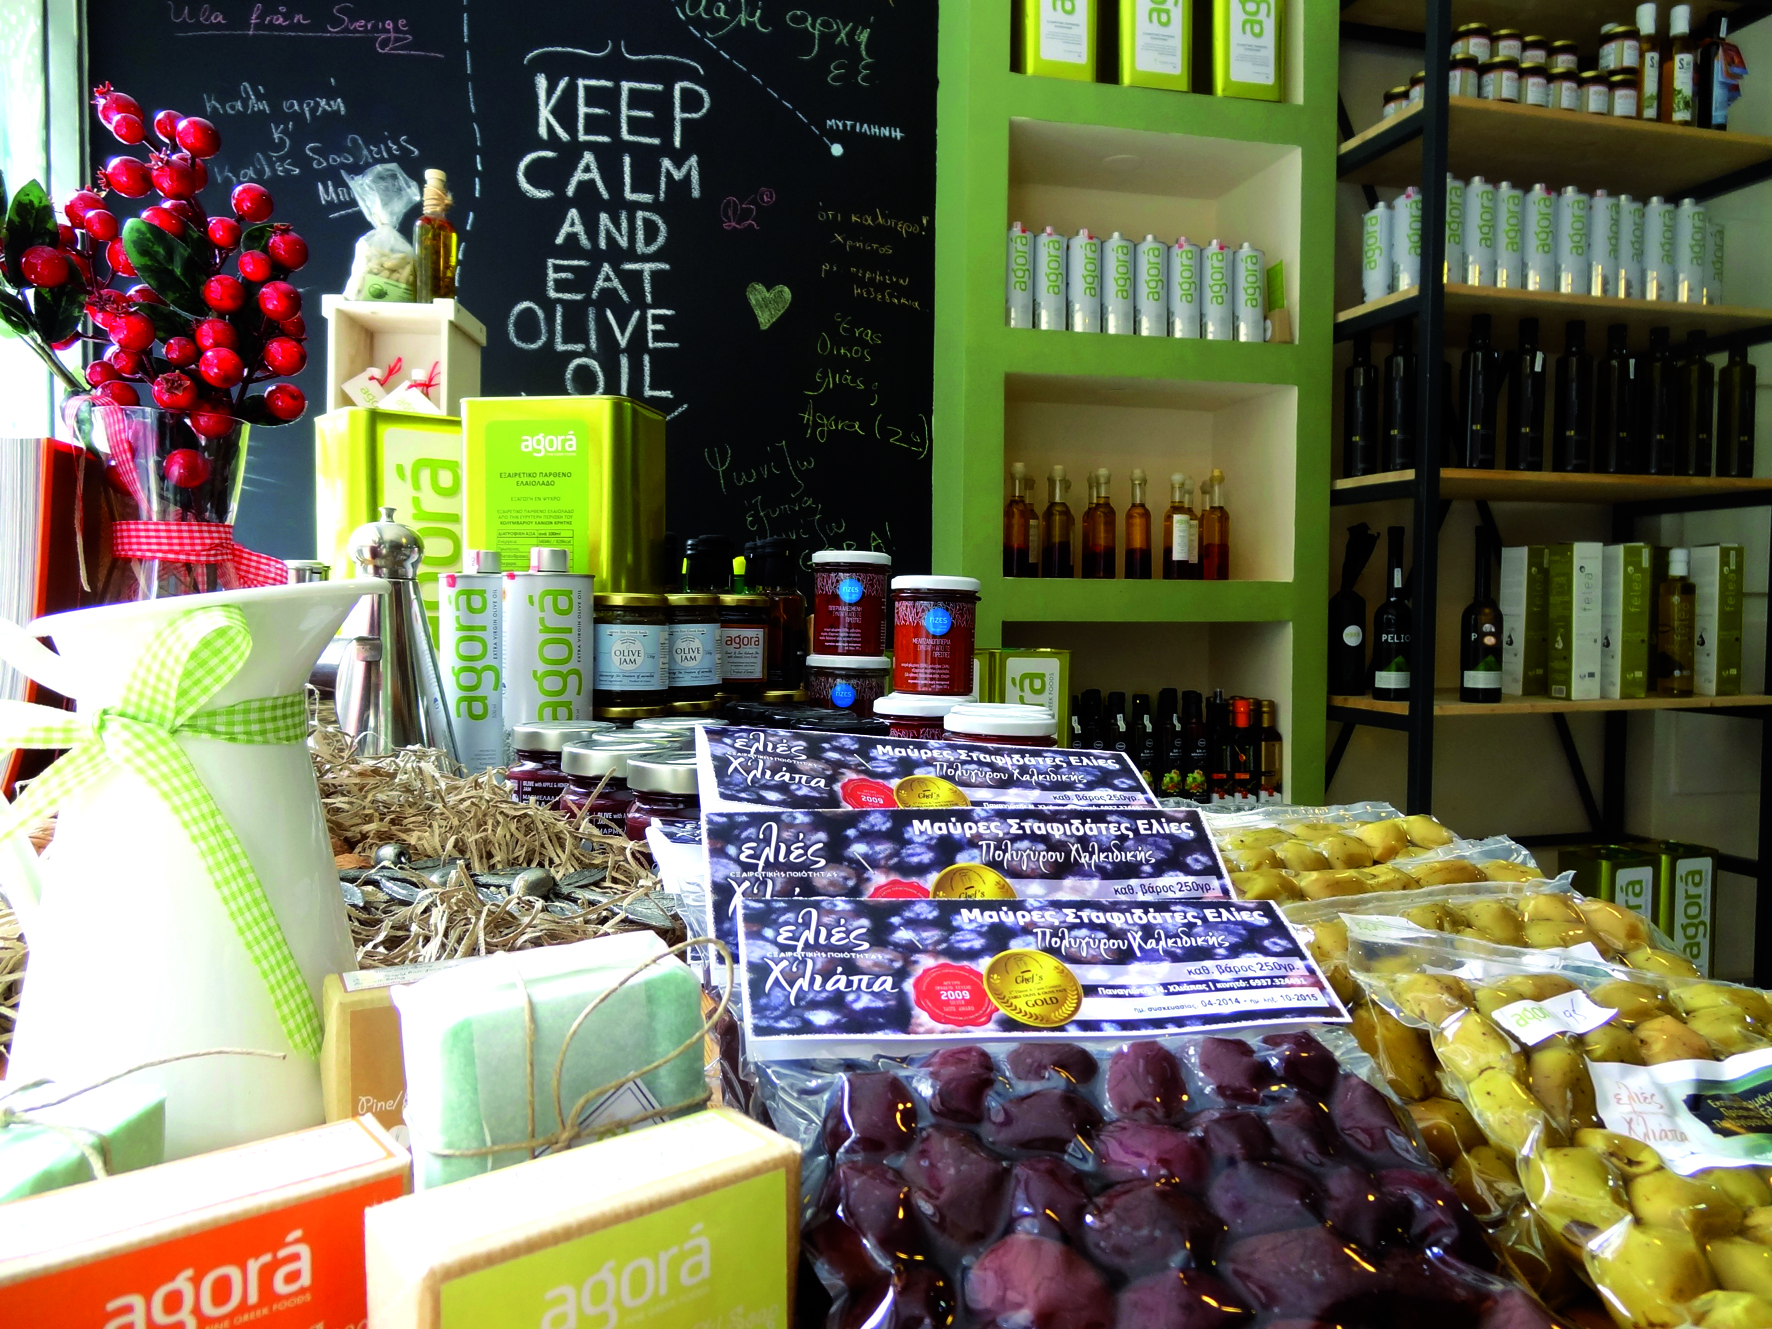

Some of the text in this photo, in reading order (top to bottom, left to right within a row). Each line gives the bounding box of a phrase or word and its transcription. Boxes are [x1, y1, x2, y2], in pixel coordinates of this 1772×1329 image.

[535, 73, 711, 148] KEEP
[826, 119, 905, 140] ΜΥΤΙΛΗΝΗ
[516, 151, 700, 202] CALM
[555, 208, 668, 255] AND
[546, 258, 670, 304] EAT
[508, 301, 679, 349] OLIVE
[565, 353, 674, 398] OIL
[520, 430, 577, 457] agorá
[675, 647, 701, 655] OLIVE
[725, 633, 760, 650] agorá
[448, 588, 500, 722] agorá
[528, 588, 583, 722] agorá
[619, 658, 637, 666] JAM
[680, 655, 697, 663] JAM
[876, 744, 954, 761] Μαύρες
[956, 749, 1067, 769] Σταφιδάτες
[1070, 755, 1120, 769] Ελίες
[861, 795, 884, 804] 2009
[1075, 793, 1107, 802] βάρος
[912, 817, 1194, 838] Μαύρες Σταφιδάτες Ελίες
[739, 821, 827, 879] ελιές
[978, 840, 1066, 874] Πολυγύρου
[1113, 884, 1138, 896] καθ.
[1140, 883, 1177, 896] βάρος
[960, 906, 1269, 926] Μαύρες Σταφιδάτες Ελίες
[777, 907, 870, 960] ελιές
[1033, 927, 1128, 959] Πολυγύρου
[764, 957, 899, 1006] Χλιάπα
[1015, 973, 1043, 984] Chef's
[1186, 962, 1300, 976] καθ. βάρος 250γρ.
[940, 990, 970, 1000] 2009
[1025, 996, 1059, 1008] GOLD
[1200, 997, 1241, 1008] 04-2014
[1280, 993, 1319, 1003] 10-2015
[102, 1229, 312, 1329] agorá
[540, 1222, 711, 1329] agorá
